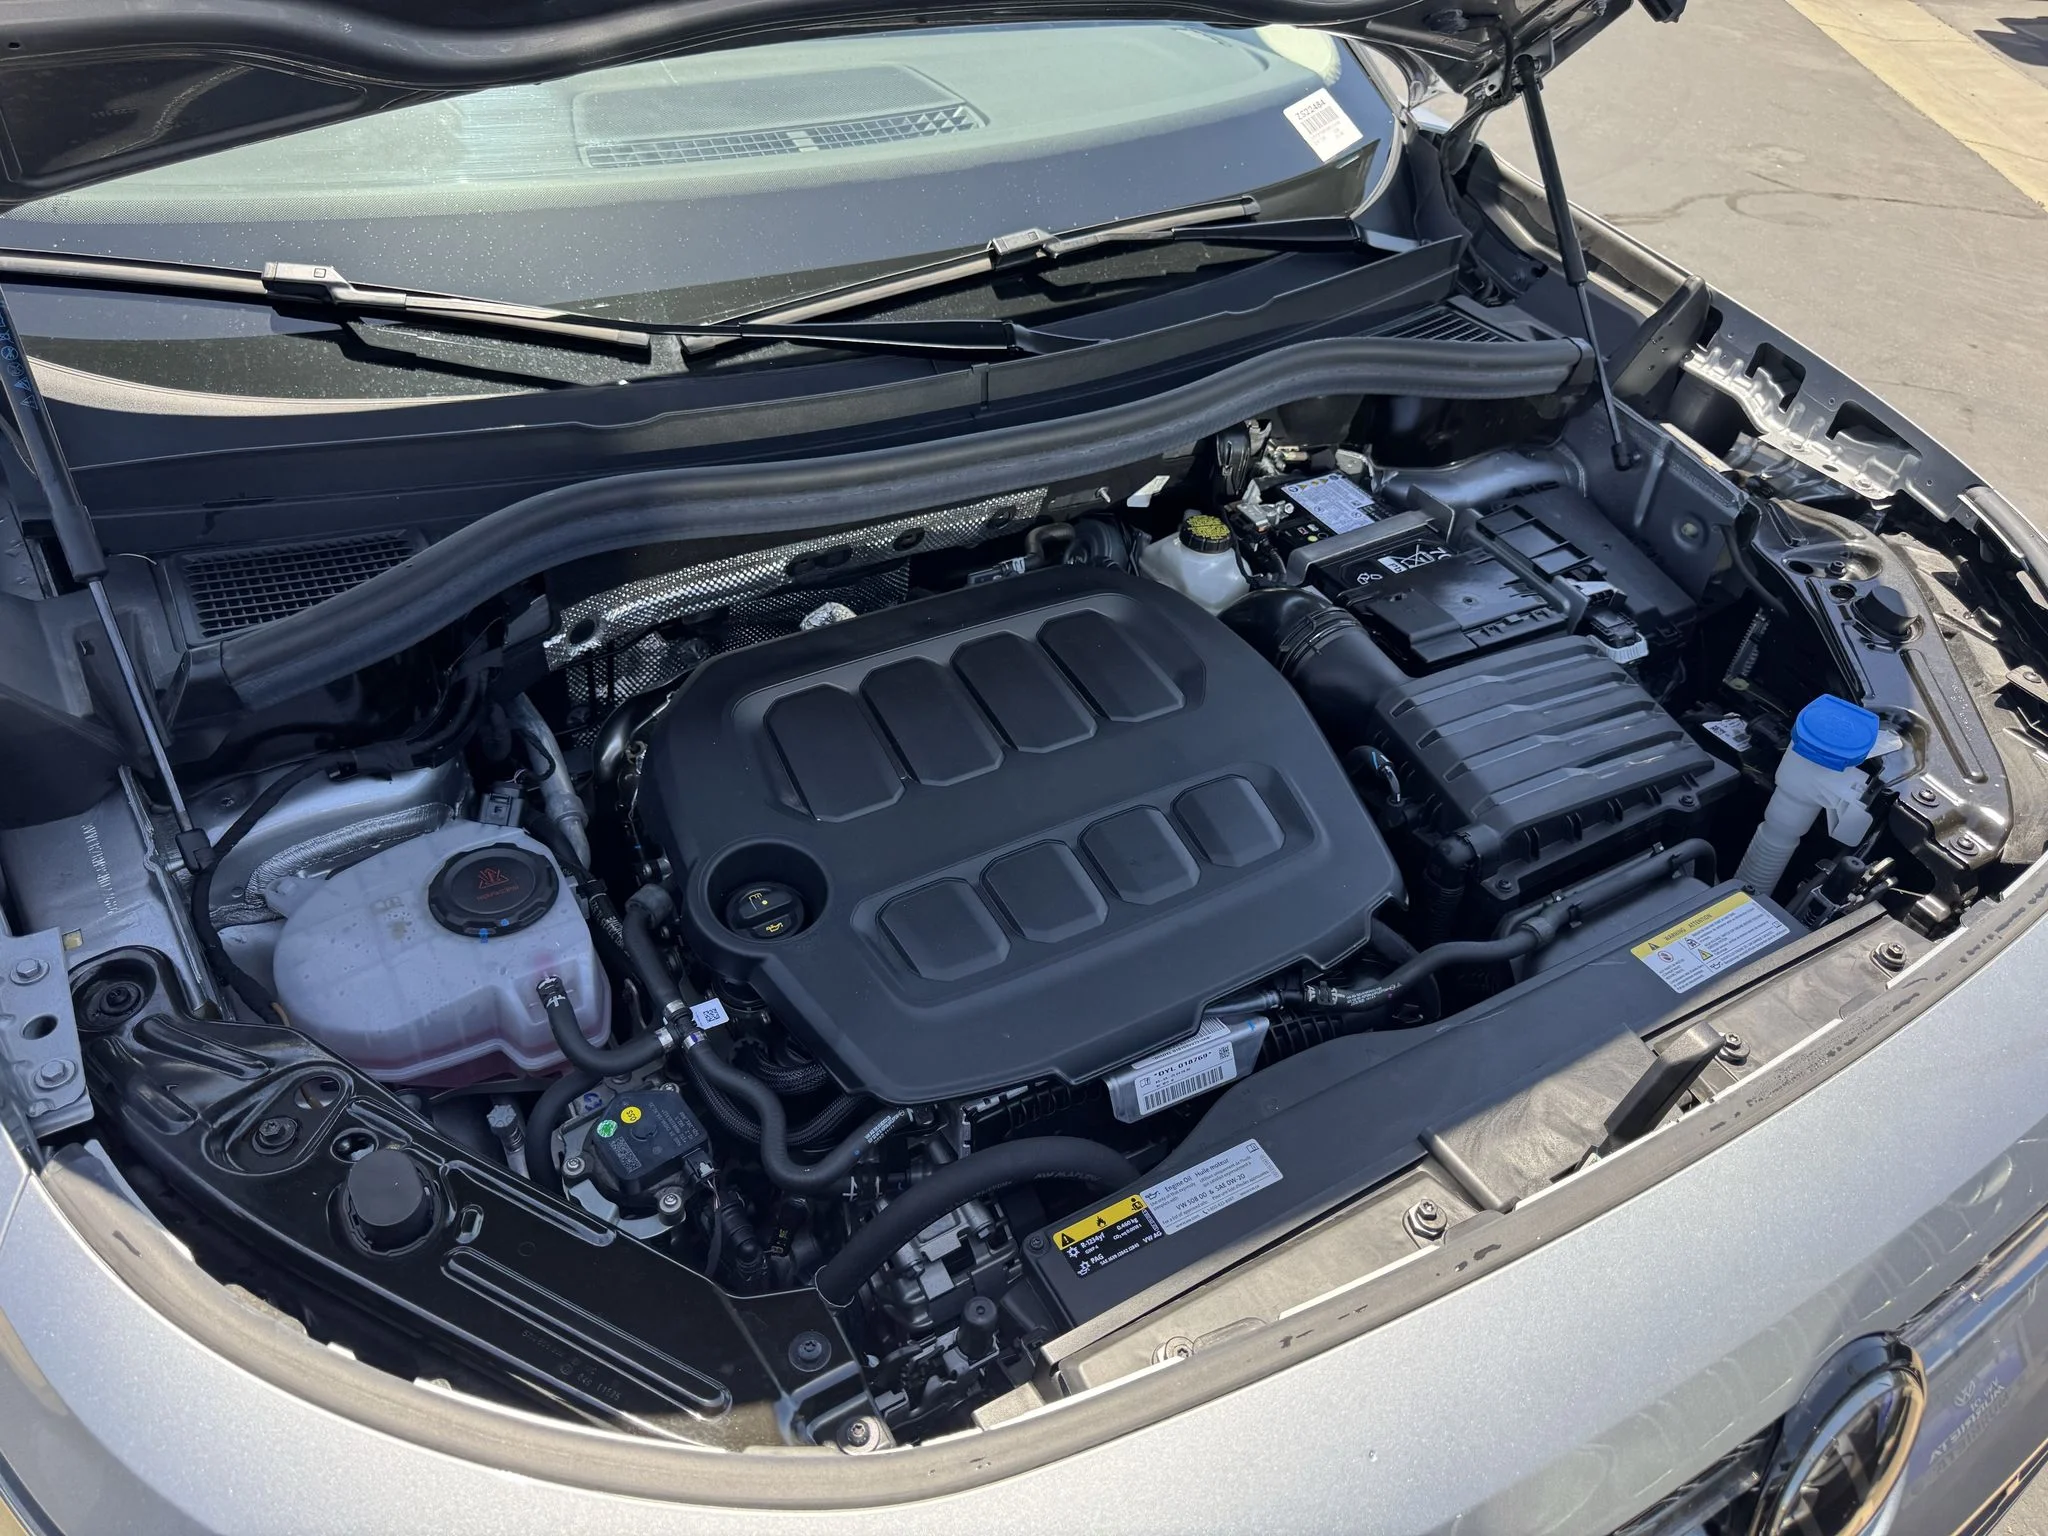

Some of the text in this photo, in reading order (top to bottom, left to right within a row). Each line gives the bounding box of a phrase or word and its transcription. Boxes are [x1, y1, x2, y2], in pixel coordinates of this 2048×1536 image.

[1688, 914, 1712, 928] ATTENTION
[1664, 927, 1686, 941] WARNING
[1194, 1158, 1229, 1177] Huile moteur
[1164, 1175, 1192, 1192] Engine Oil
[1175, 1201, 1187, 1210] VW
[1186, 1195, 1199, 1205] 508
[1198, 1191, 1207, 1199] 00
[1214, 1182, 1227, 1191] SAE
[1225, 1173, 1246, 1186] 0W-20
[1080, 1232, 1105, 1248] R-1234yf
[1142, 1230, 1162, 1243] VW AG
[1090, 1253, 1104, 1264] PAG
